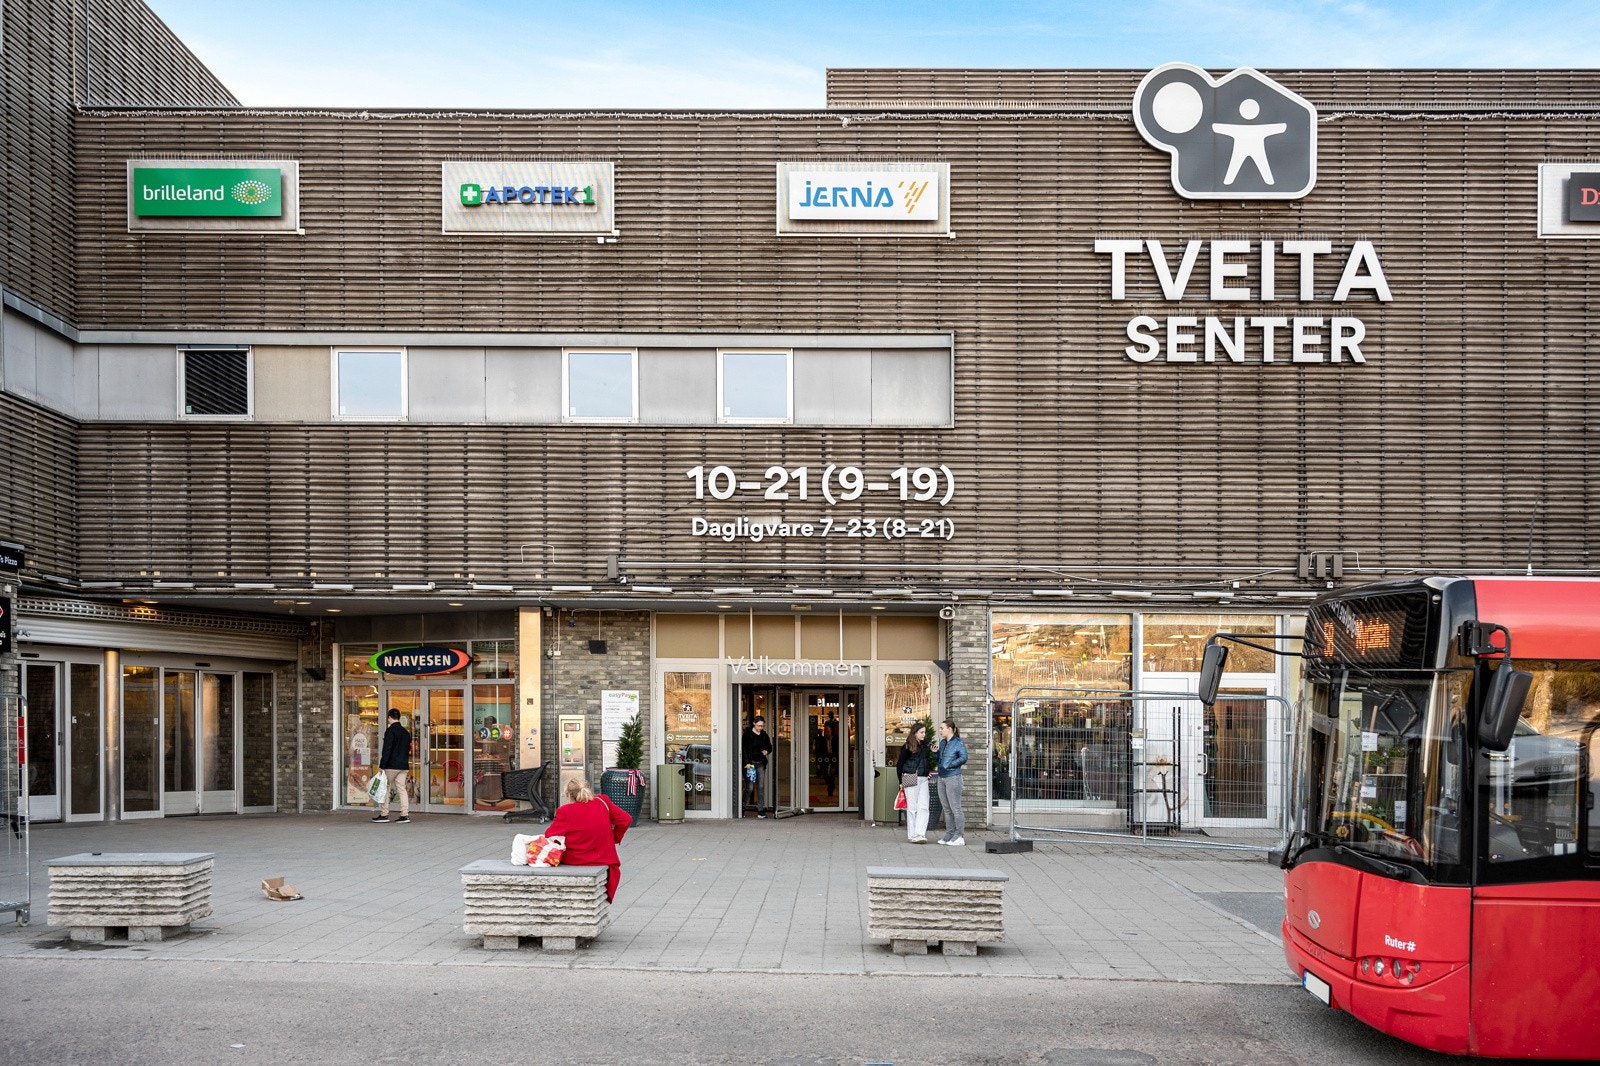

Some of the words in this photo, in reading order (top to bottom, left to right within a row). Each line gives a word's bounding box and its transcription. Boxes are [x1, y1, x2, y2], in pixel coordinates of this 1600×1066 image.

[143, 185, 225, 201] brilleland
[1581, 188, 1600, 206] D
[1094, 240, 1394, 301] TVEITA
[1125, 315, 1367, 363] SENTER
[691, 517, 814, 542] Dagligvare
[384, 655, 452, 667] NARVESEN
[728, 655, 862, 676] Velkommen
